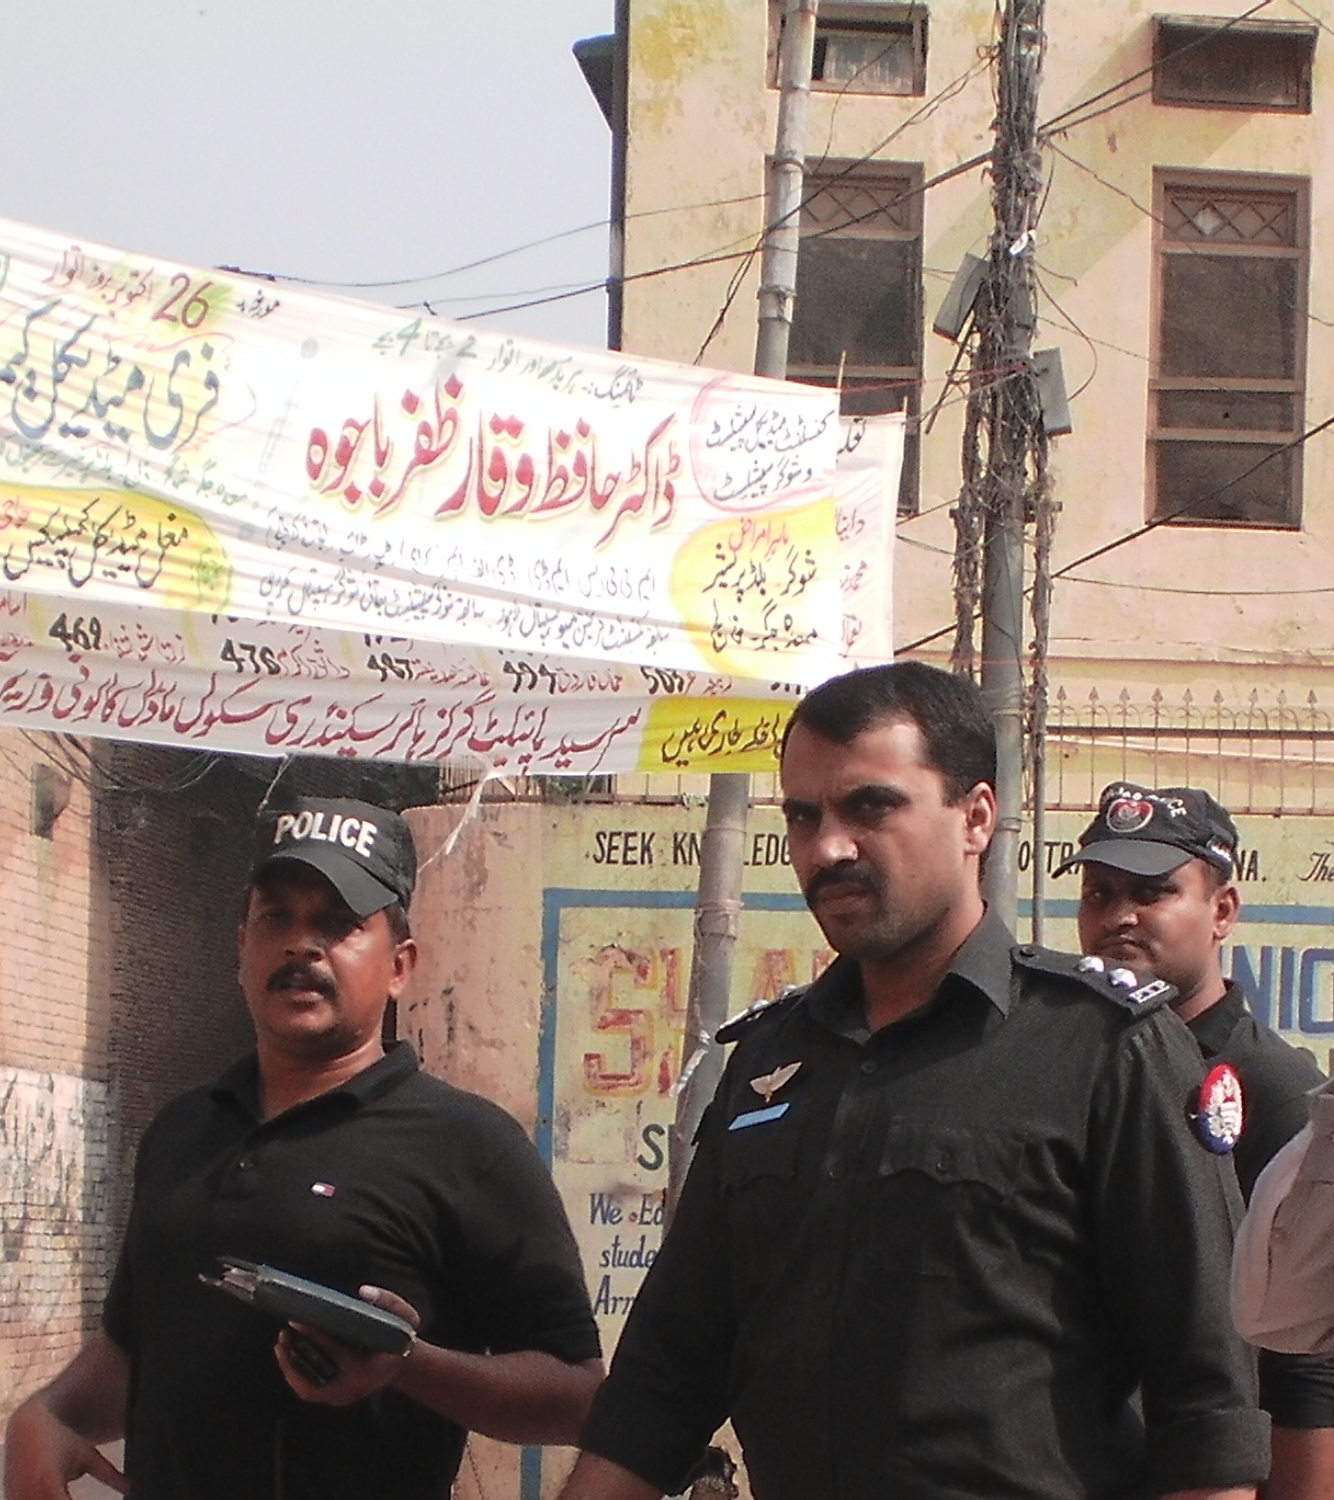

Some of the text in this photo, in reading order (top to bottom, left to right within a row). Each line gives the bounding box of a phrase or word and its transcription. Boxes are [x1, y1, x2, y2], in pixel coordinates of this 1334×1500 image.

[152, 271, 214, 329] 26
[395, 317, 423, 357] 4
[455, 334, 478, 358] 2
[10, 314, 146, 440] میڈیکل
[143, 341, 220, 452] فری
[372, 372, 466, 518] ظفر
[433, 408, 537, 519] وقار
[528, 415, 622, 514] حافظ
[593, 412, 683, 550] ڈاکٹر
[171, 671, 287, 740] سکول
[274, 810, 378, 858] POLICE
[593, 830, 656, 866] SEEK
[589, 1193, 623, 1225] We
